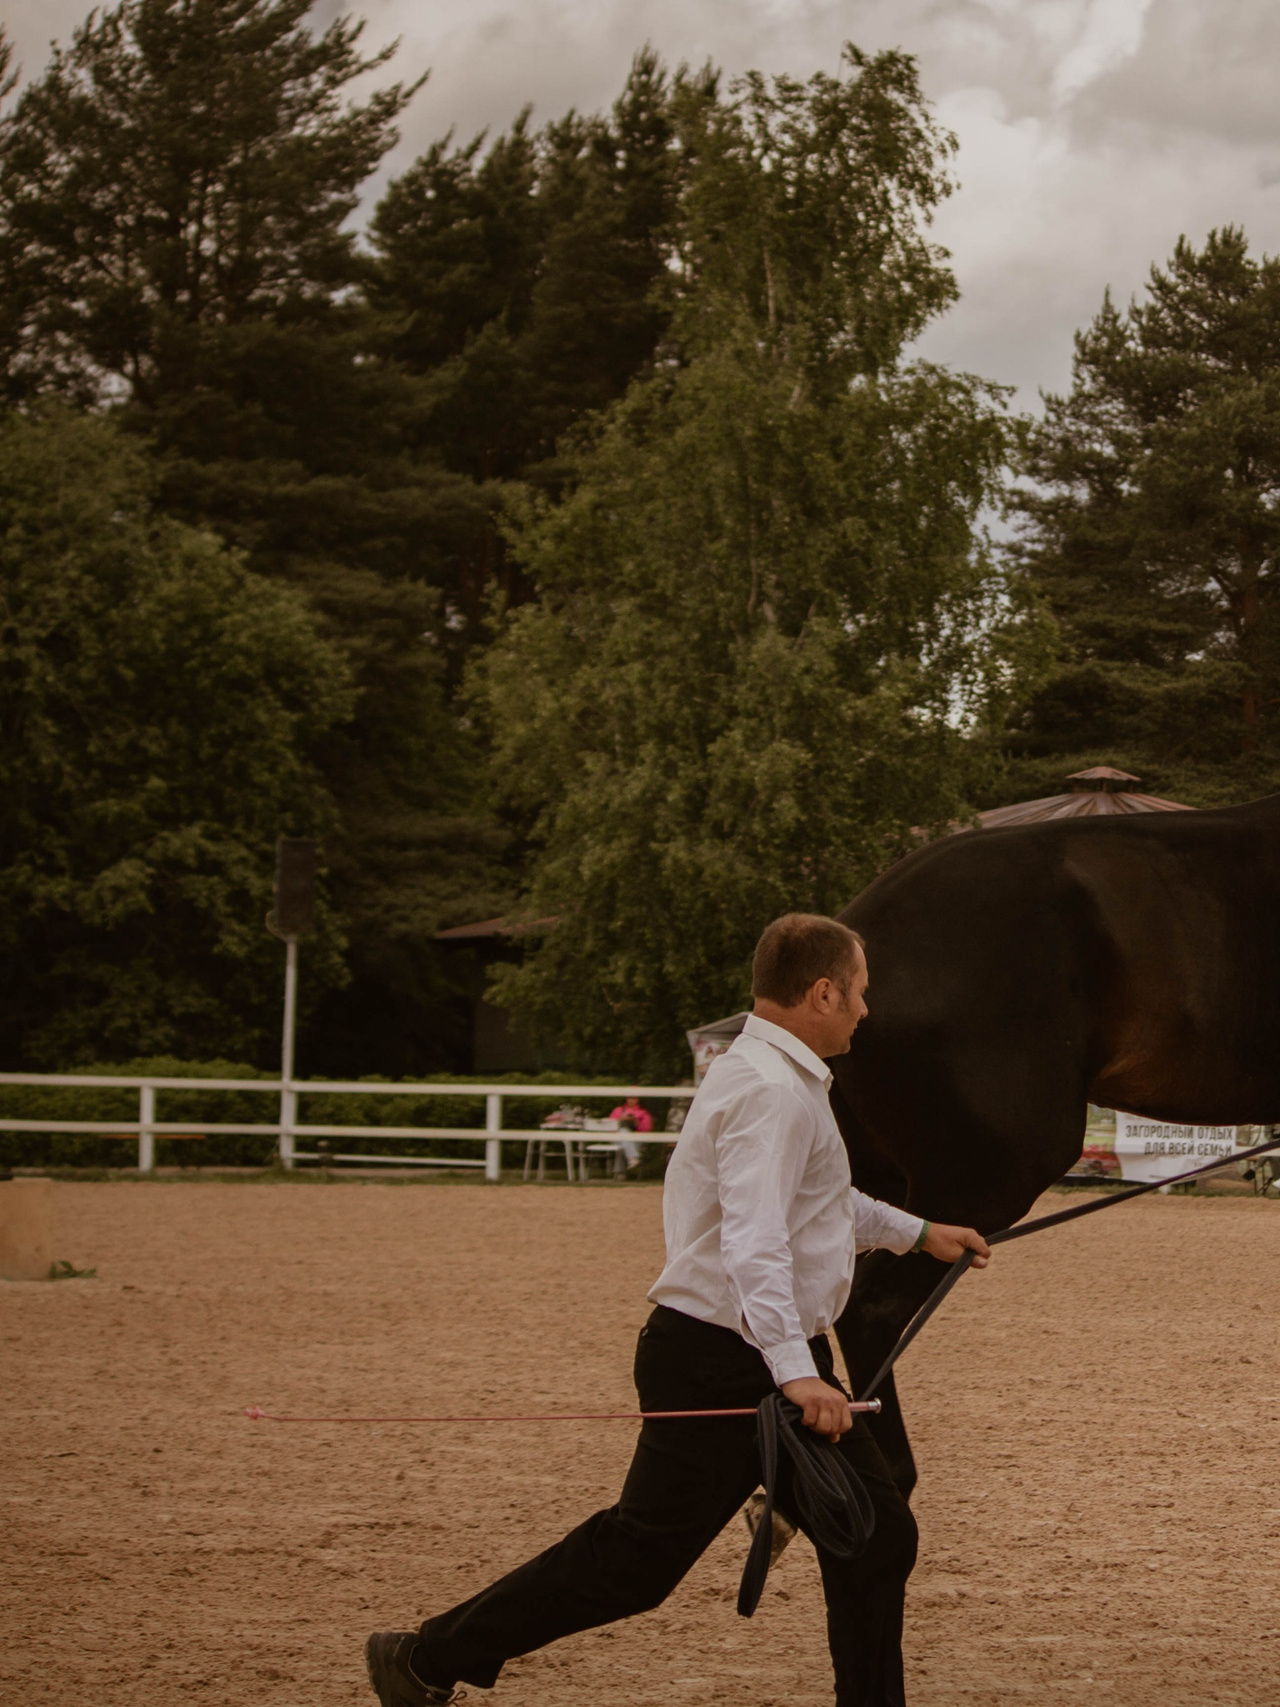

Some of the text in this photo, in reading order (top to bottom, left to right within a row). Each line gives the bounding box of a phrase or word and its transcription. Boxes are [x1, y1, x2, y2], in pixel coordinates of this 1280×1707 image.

[1197, 1126, 1233, 1140] ОТДЫХ
[1144, 1141, 1232, 1158] ДЛЯ ВСЕЙ СЕМЬИ
